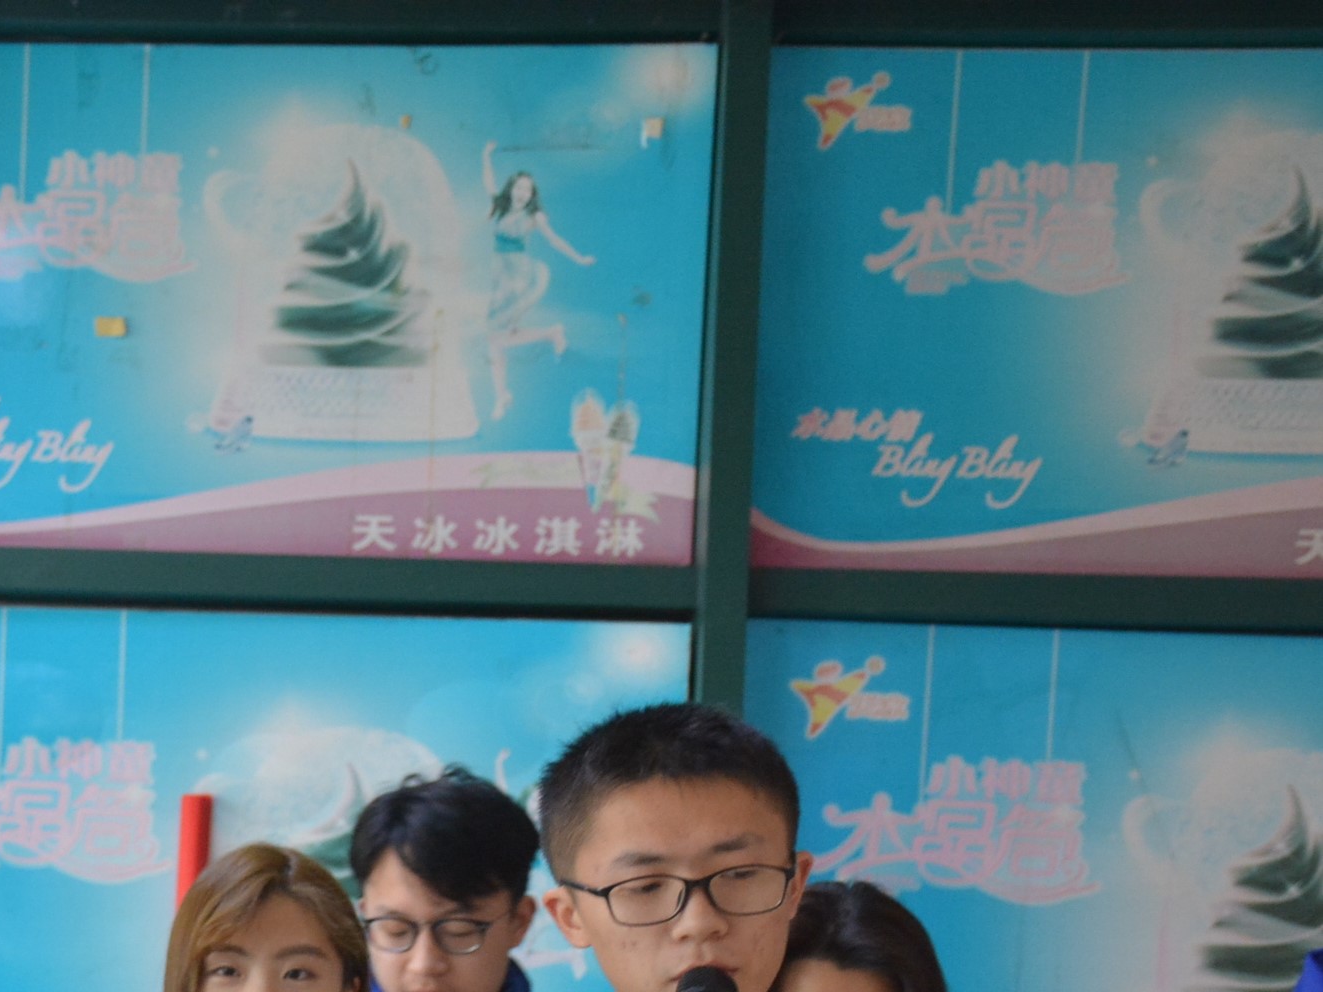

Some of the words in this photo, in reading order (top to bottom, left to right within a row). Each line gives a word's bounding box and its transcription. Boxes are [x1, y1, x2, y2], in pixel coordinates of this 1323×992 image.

[32, 419, 114, 492] Bling
[873, 434, 959, 507] Bling
[957, 435, 1042, 509] Bling
[351, 514, 644, 557] 天冰冰淇淋
[5, 737, 155, 783] 小神童
[928, 755, 1086, 805] 小神童
